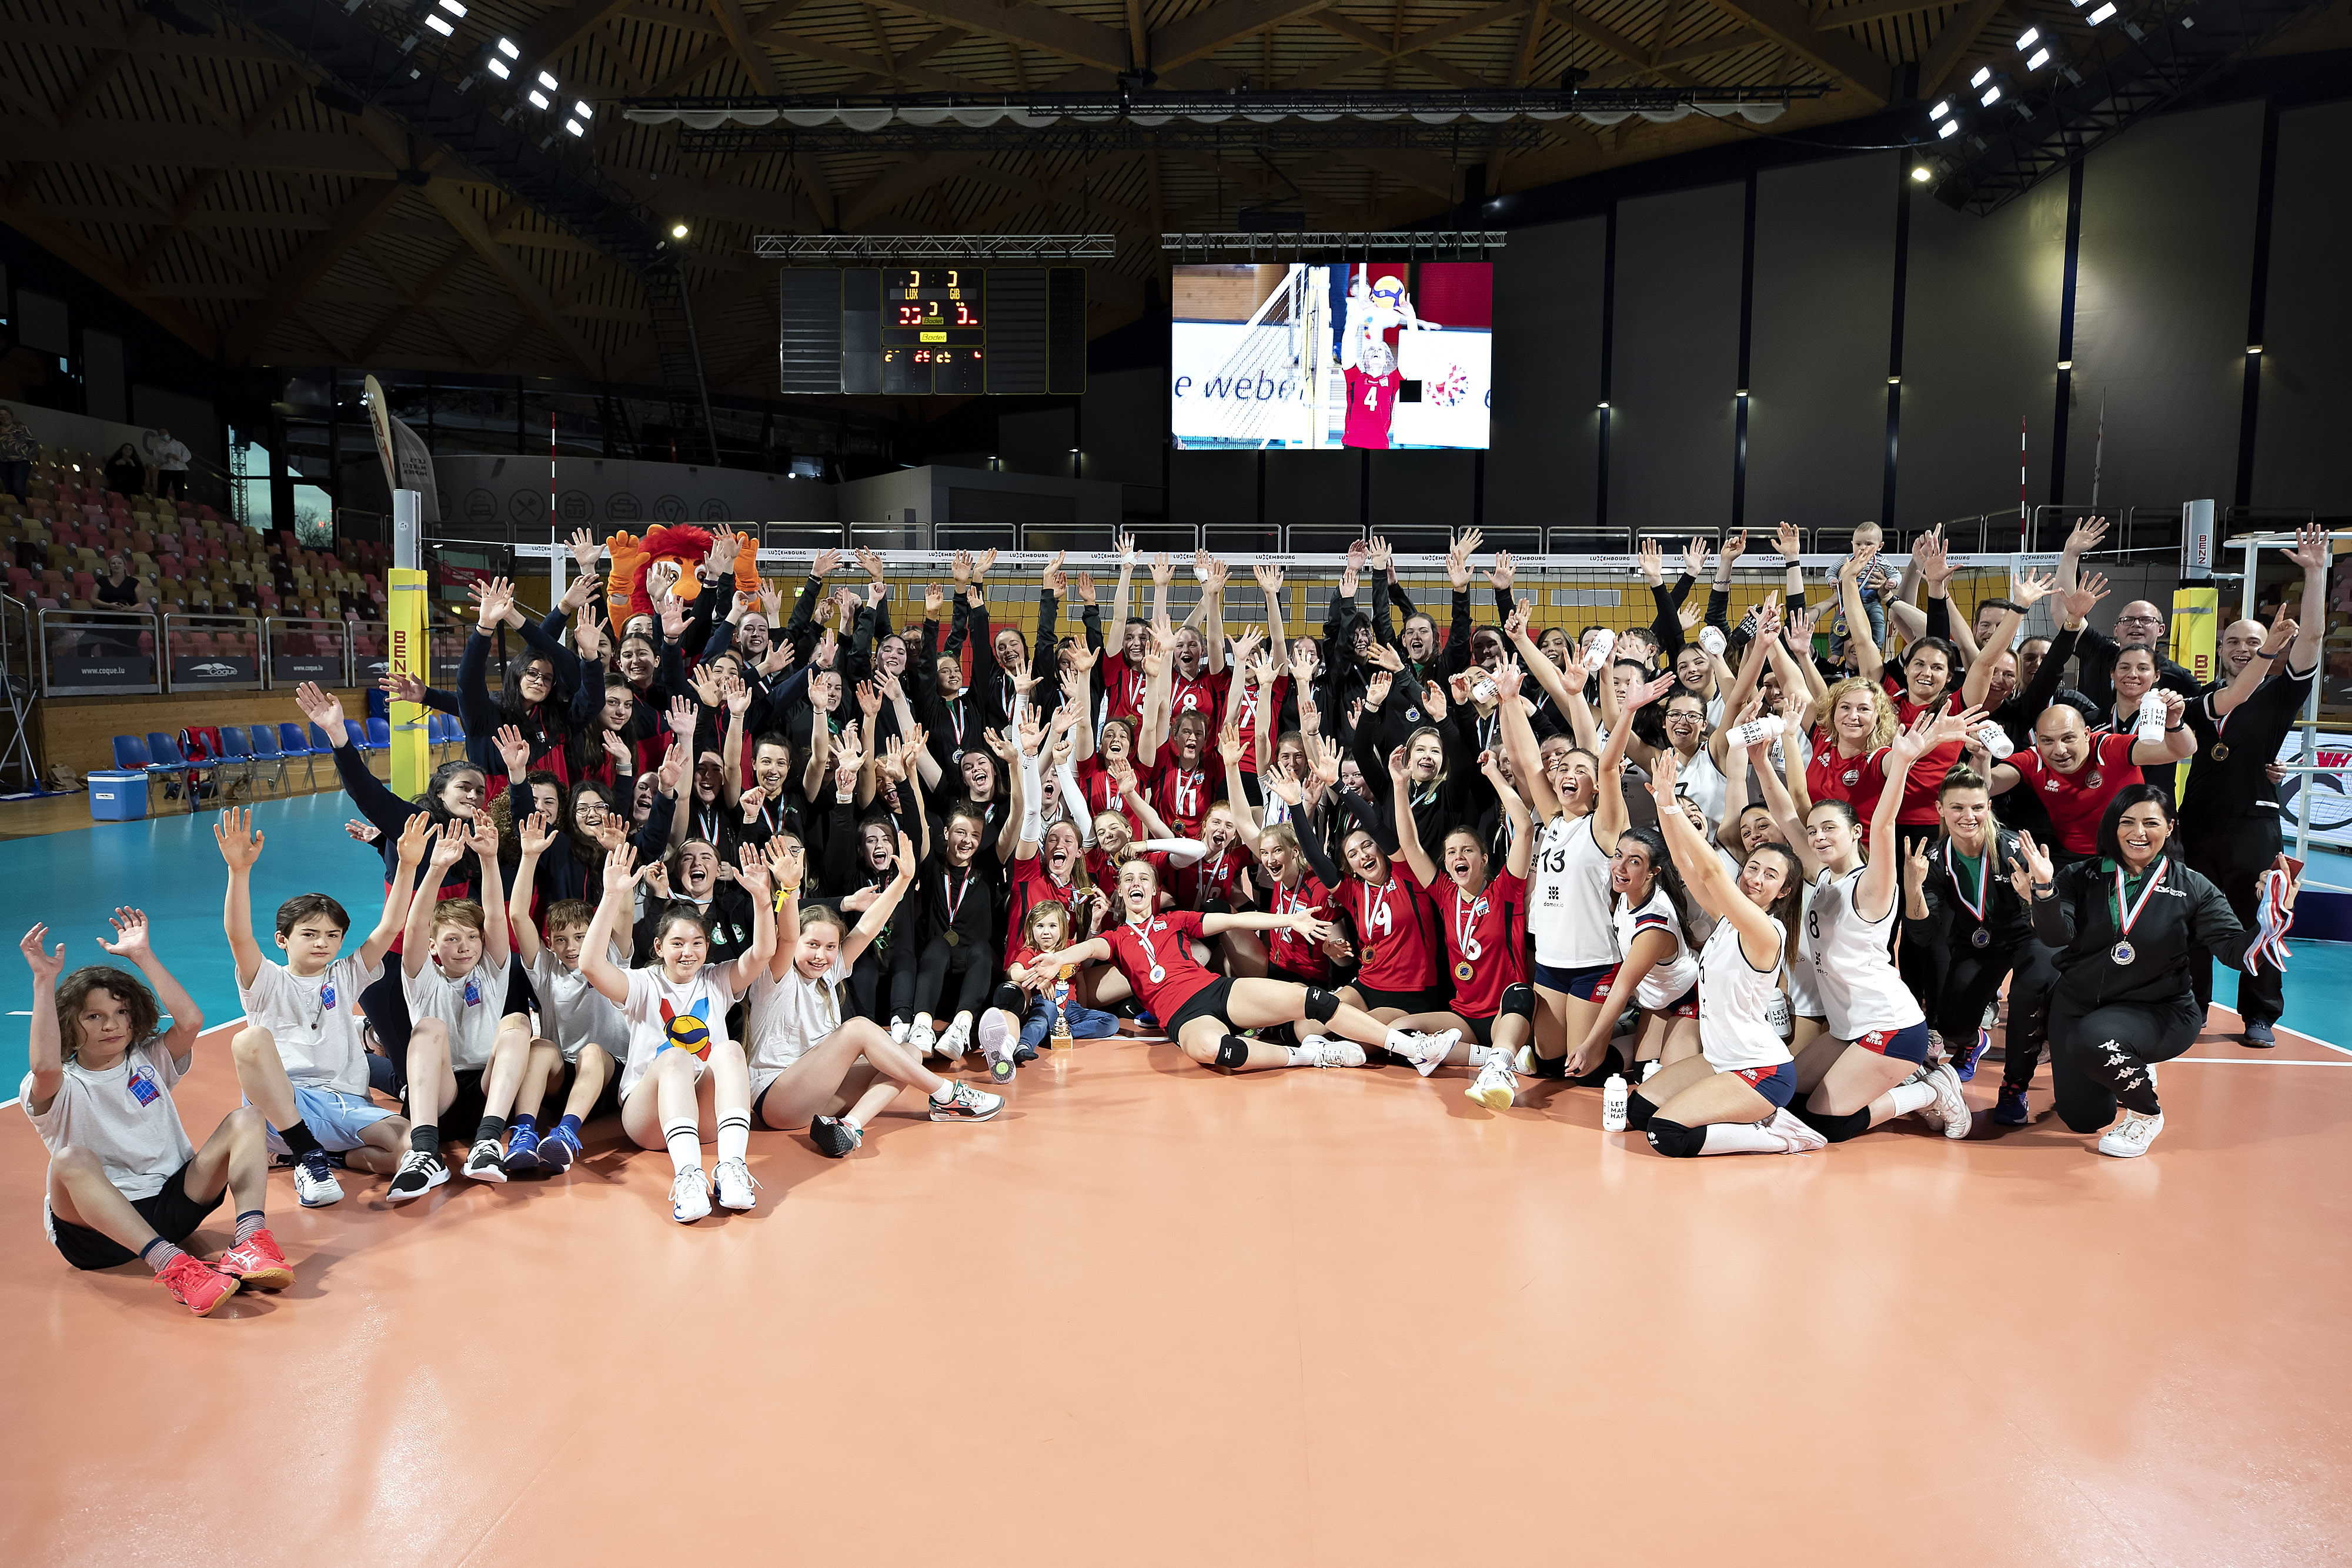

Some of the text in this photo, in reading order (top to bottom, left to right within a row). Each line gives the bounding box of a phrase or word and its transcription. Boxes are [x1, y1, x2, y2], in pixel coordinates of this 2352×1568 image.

[905, 288, 918, 300] LUX
[950, 288, 960, 300] GIB
[1205, 370, 1304, 400] webe
[1364, 386, 1378, 412] 4
[2198, 534, 2207, 564] BENZ
[394, 630, 406, 677] BEN
[81, 667, 125, 676] www.coque.lu
[209, 667, 238, 677] Coque
[2194, 654, 2209, 684] BE
[1541, 848, 1565, 873] 13
[1809, 910, 1820, 939] 8
[324, 1001, 336, 1011] FLV
[1866, 1038, 1883, 1046] errea
